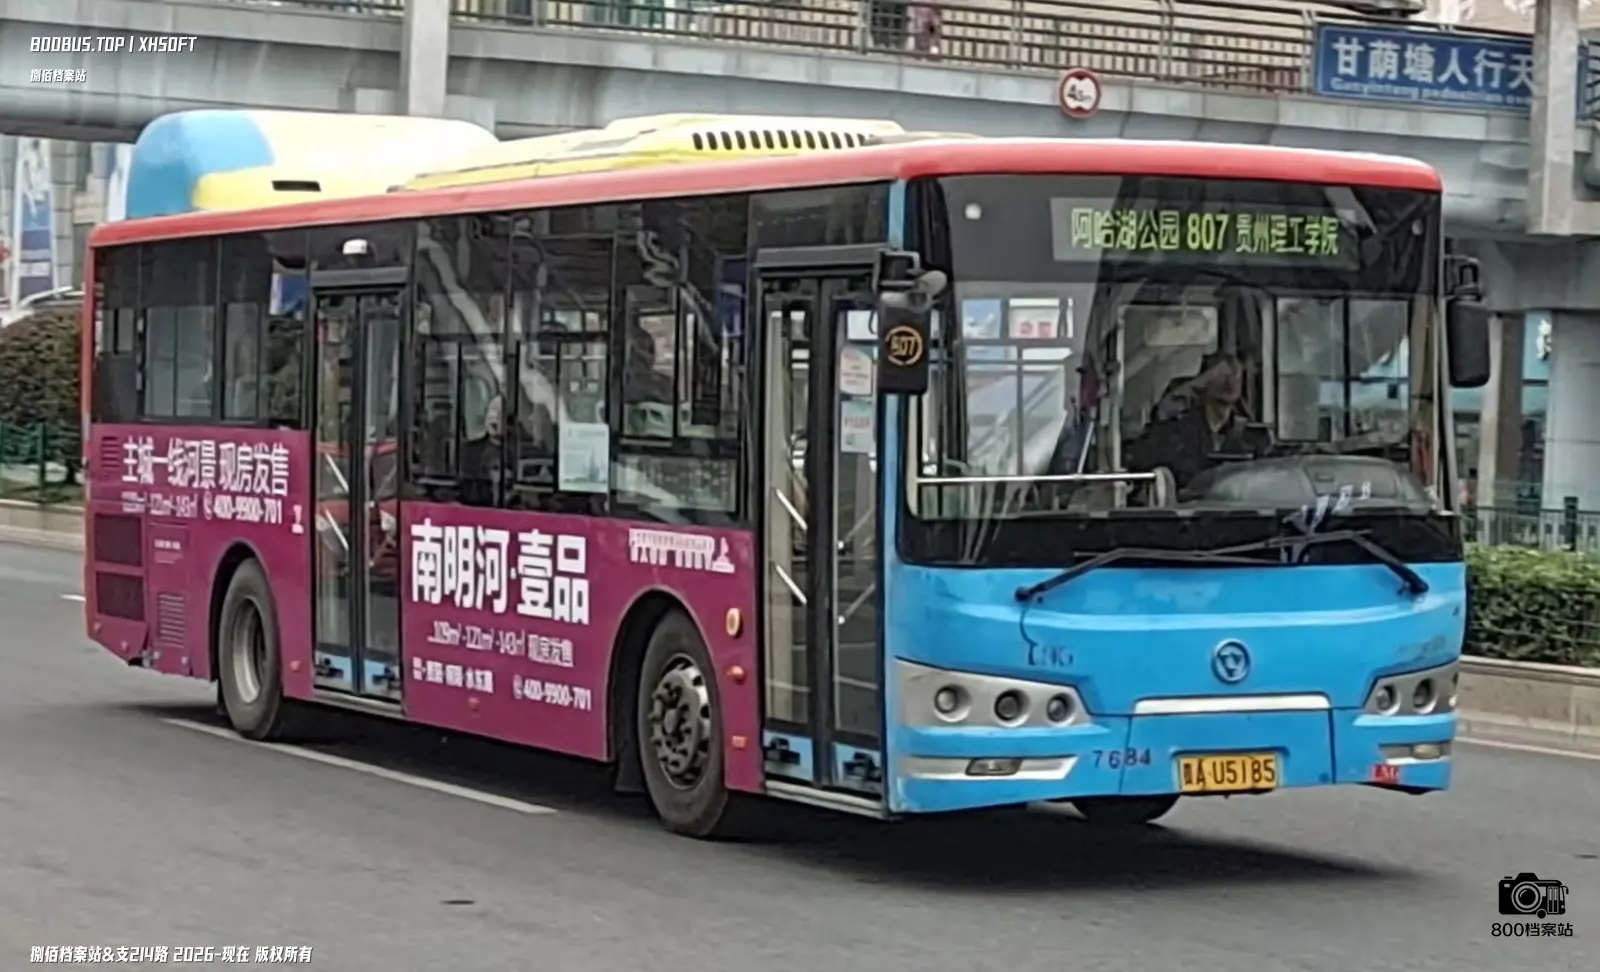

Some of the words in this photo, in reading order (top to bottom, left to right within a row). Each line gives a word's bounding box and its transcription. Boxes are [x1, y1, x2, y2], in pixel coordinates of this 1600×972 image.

[1071, 207, 1180, 249] 阿哈湖公园
[1187, 213, 1229, 249] 807
[411, 518, 590, 625] 南明河·壹品
[1092, 747, 1151, 769] 7684
